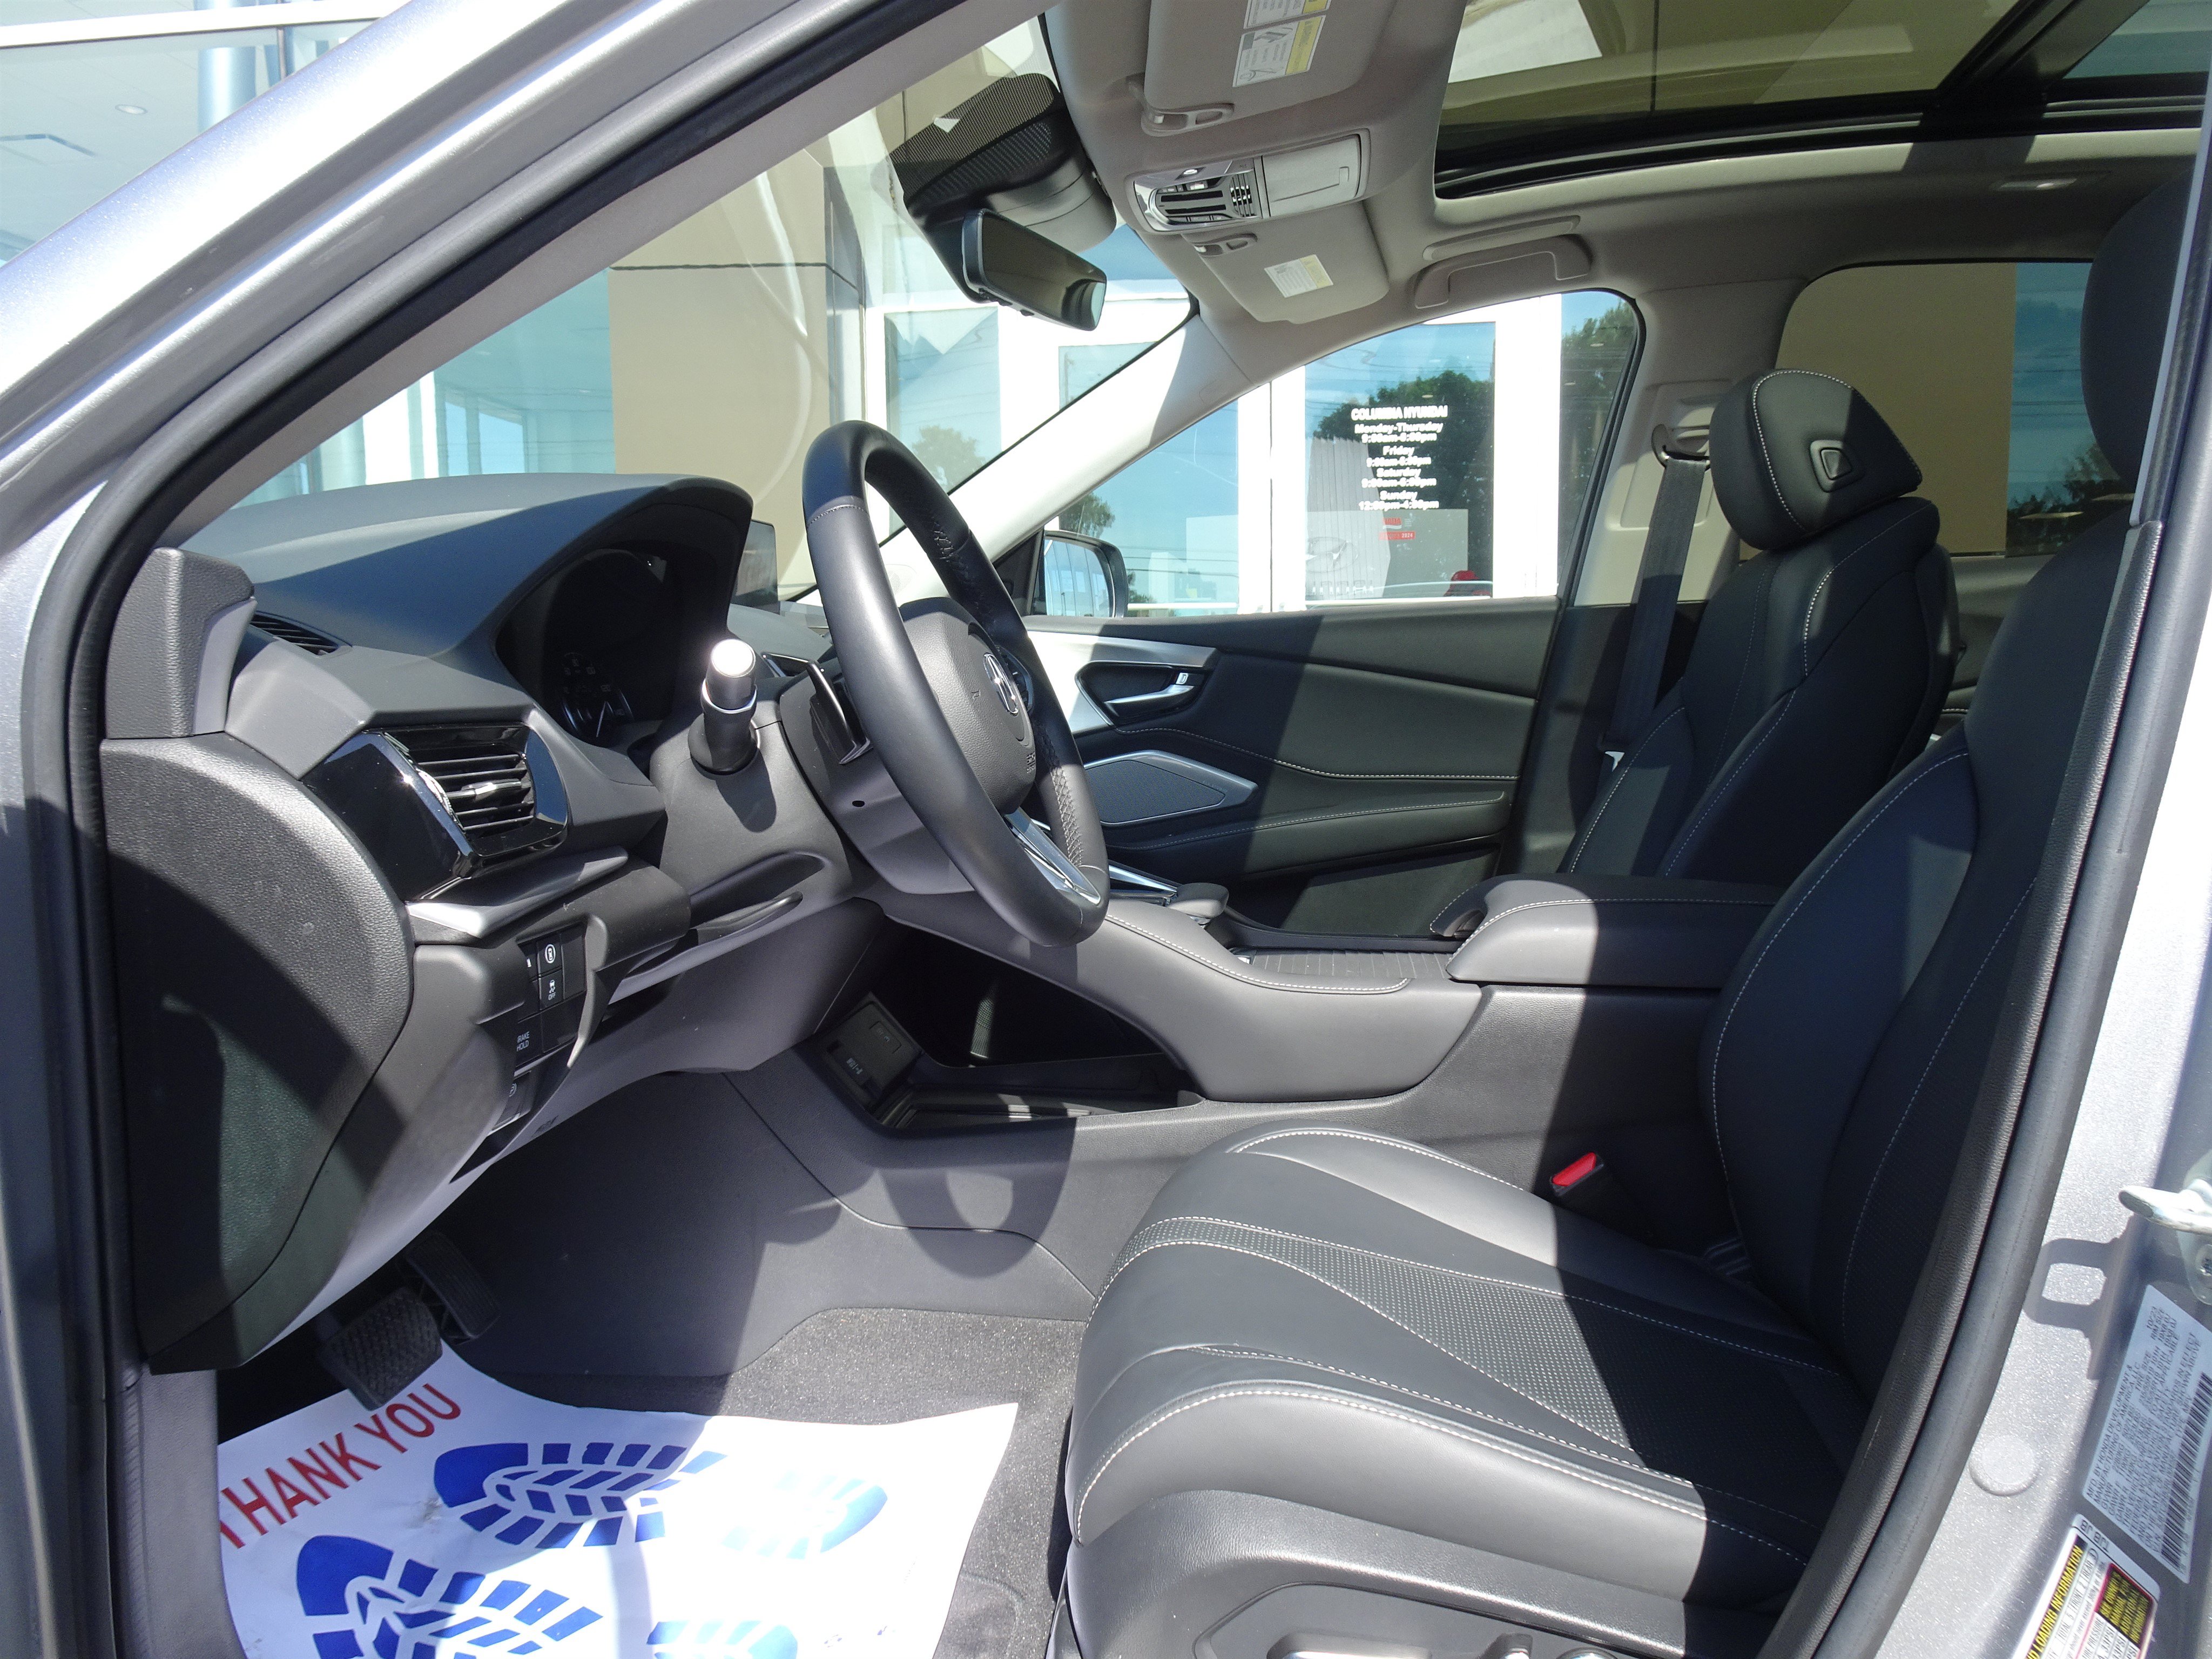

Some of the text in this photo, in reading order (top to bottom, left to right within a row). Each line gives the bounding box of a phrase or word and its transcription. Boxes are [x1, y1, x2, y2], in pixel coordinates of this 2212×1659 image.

[1404, 405, 1448, 419] HYUNDAI
[1382, 446, 1415, 456] Friday
[1377, 467, 1421, 478] Saturday
[1380, 490, 1418, 501] Sunday
[548, 992, 556, 1000] OFF
[2149, 1305, 2165, 1341] RIM SIZE
[2134, 1348, 2152, 1392] TIRE SIZE
[2106, 1371, 2130, 1434] DEVELOPMENT
[354, 1384, 461, 1453] YOU
[2096, 1431, 2111, 1465] HONDA
[2093, 1431, 2120, 1505] MANUFACTURING
[2114, 1419, 2123, 1434] OF
[2093, 1462, 2102, 1477] BY
[2080, 1558, 2094, 1579] REAR
[2032, 1608, 2058, 1654] LOADING
[2050, 1543, 2084, 1611] INFORMATION
[2068, 1587, 2083, 1610] FRONT
[2098, 1599, 2112, 1618] SEE
[2109, 1594, 2126, 1627] MANUAL
[2056, 1620, 2071, 1641] TOTAL
[2075, 1618, 2086, 1635] never
[2086, 1617, 2104, 1649] PRESSURE
[2100, 1626, 2116, 1653] 33PSI
